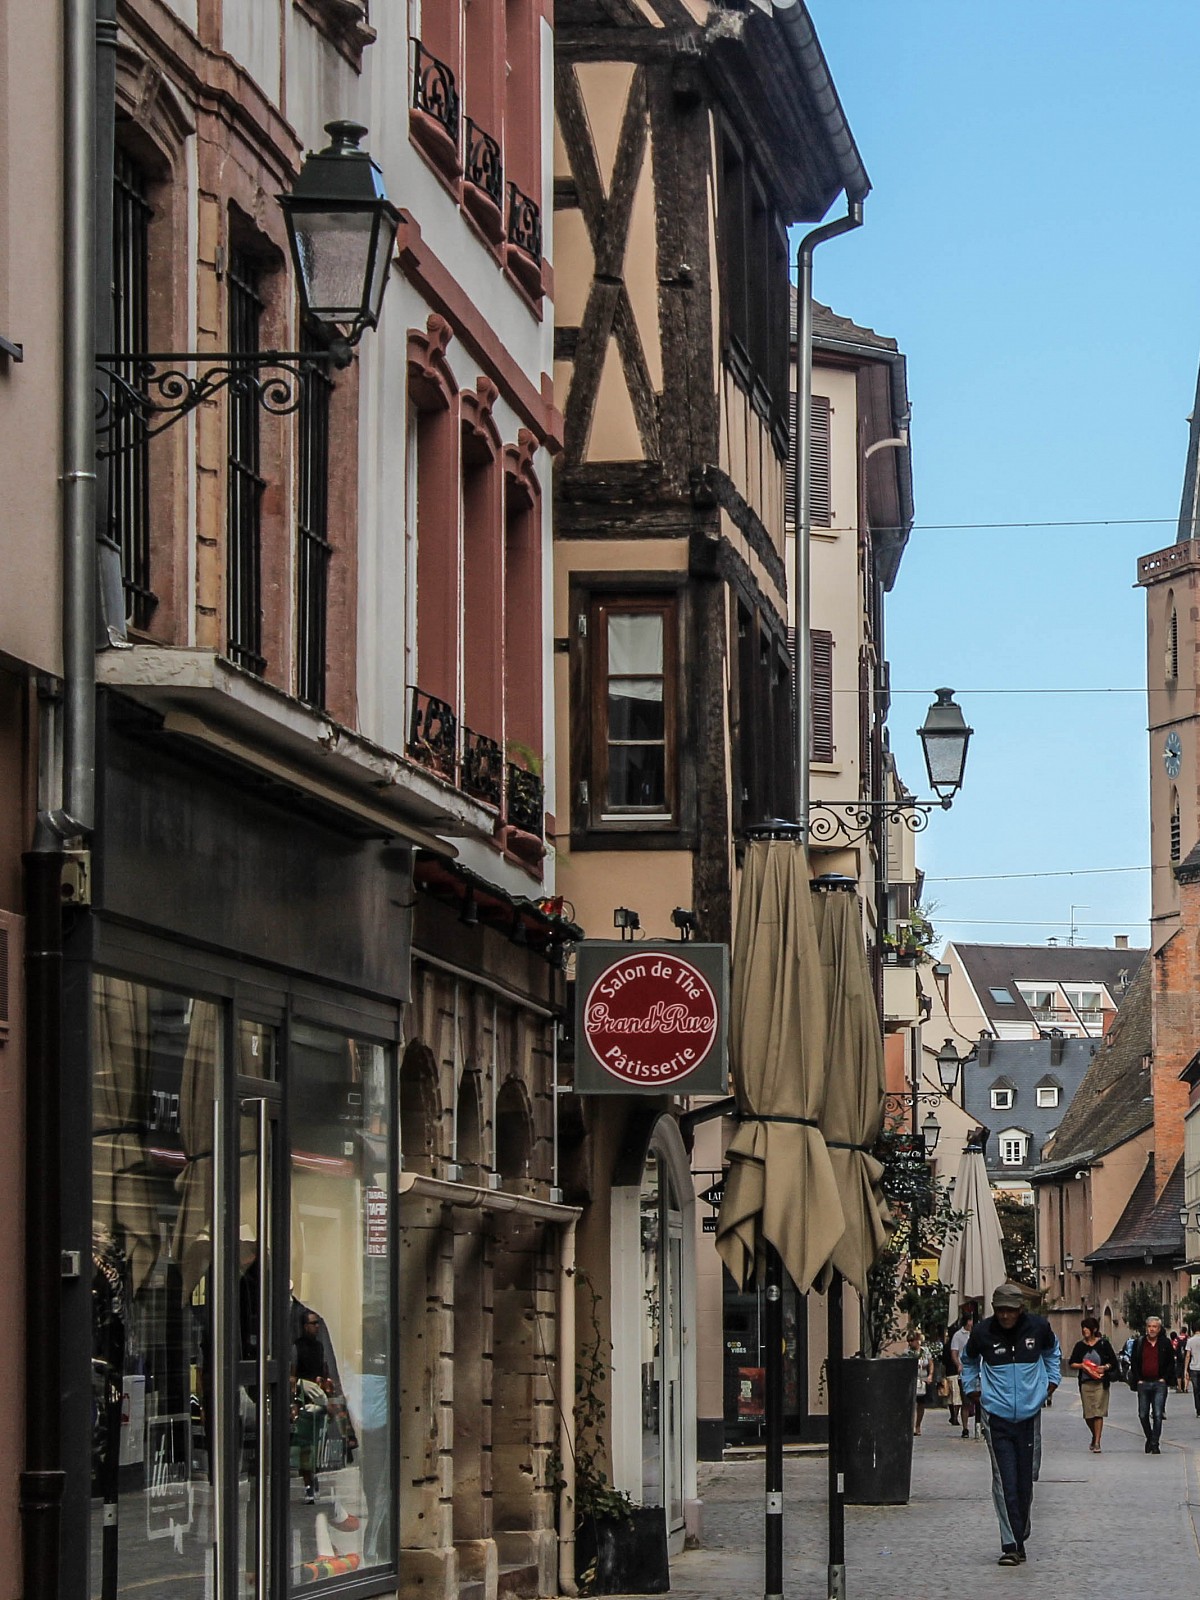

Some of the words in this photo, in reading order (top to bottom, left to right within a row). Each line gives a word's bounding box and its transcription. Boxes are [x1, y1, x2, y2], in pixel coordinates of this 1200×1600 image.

[600, 965, 646, 998] Salon
[651, 961, 673, 979] de
[675, 968, 704, 1000] Thé
[587, 1001, 715, 1034] Grand'Rue
[605, 1046, 696, 1077] Pâtisserie
